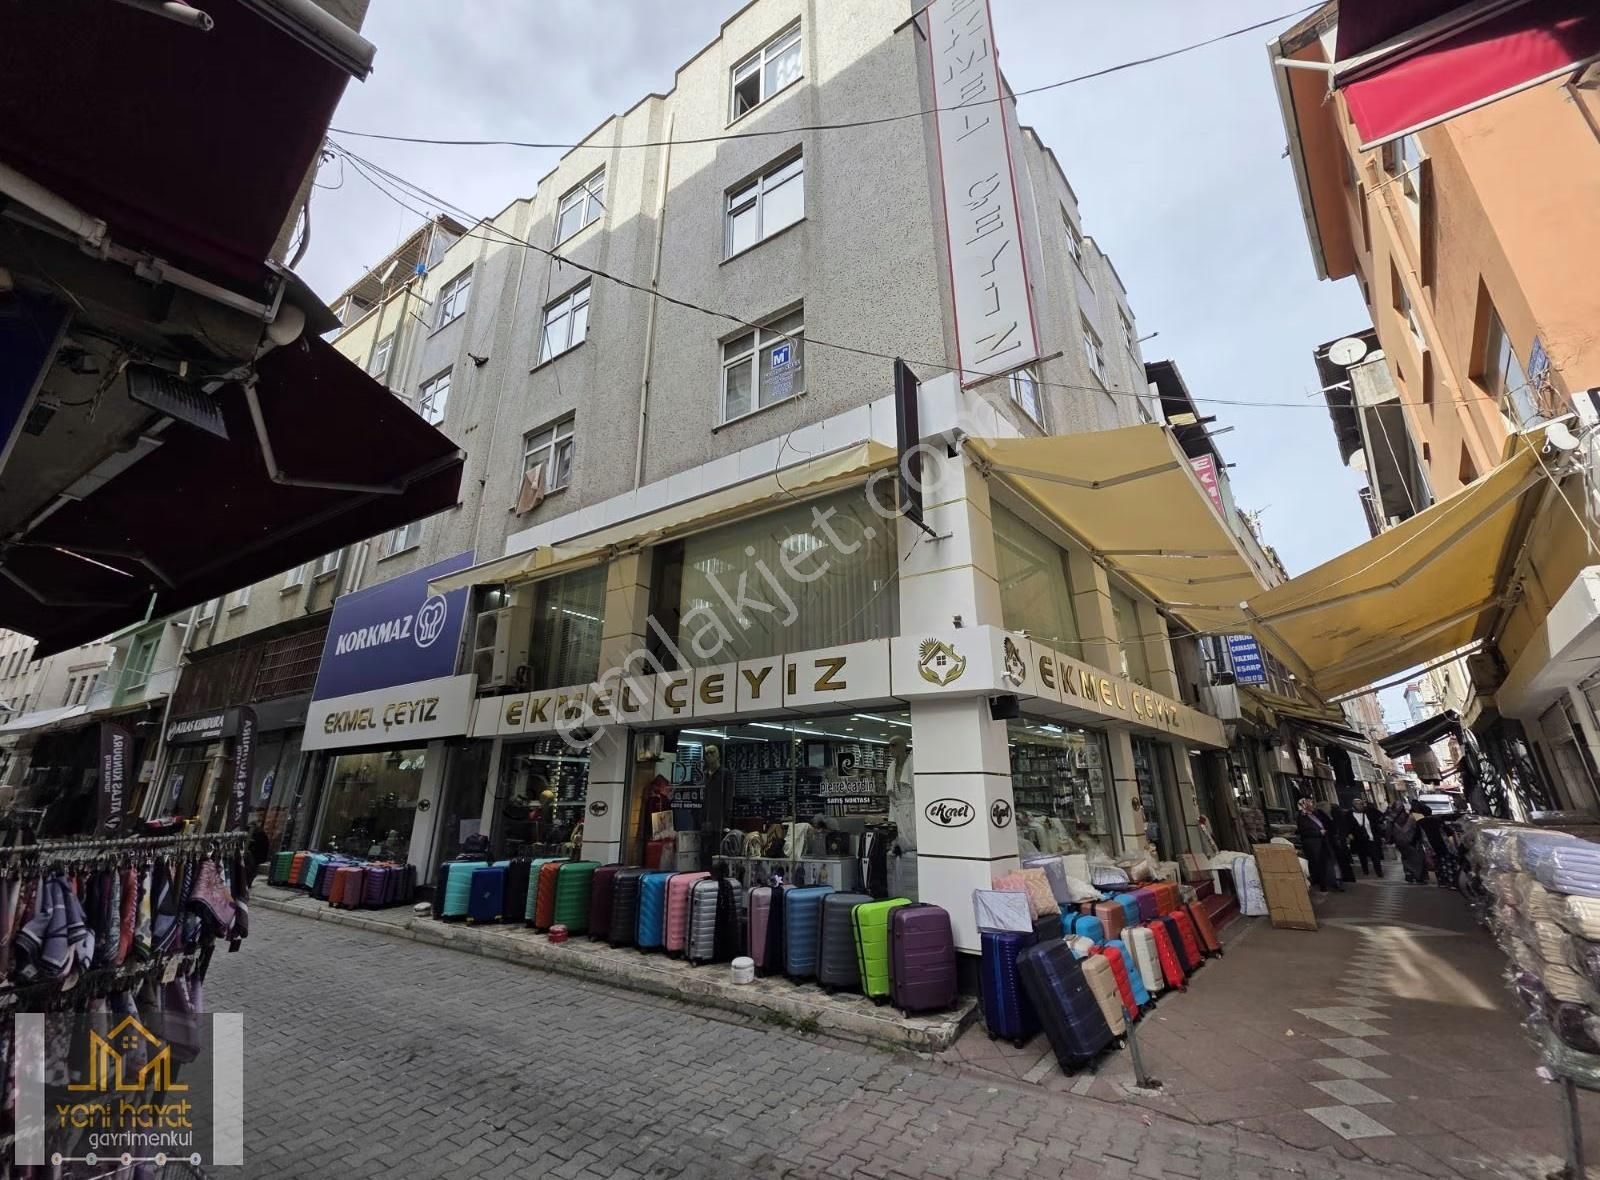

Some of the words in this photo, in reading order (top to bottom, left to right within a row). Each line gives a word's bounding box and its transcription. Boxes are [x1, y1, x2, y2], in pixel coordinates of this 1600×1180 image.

[335, 615, 413, 655] KORKMAZ
[1038, 655, 1126, 710] EKMEL
[324, 707, 377, 735] EKMEL
[505, 686, 640, 726] EKMEL
[175, 719, 194, 734] ATLAS
[820, 780, 845, 794] pierre
[846, 778, 874, 793] cardin
